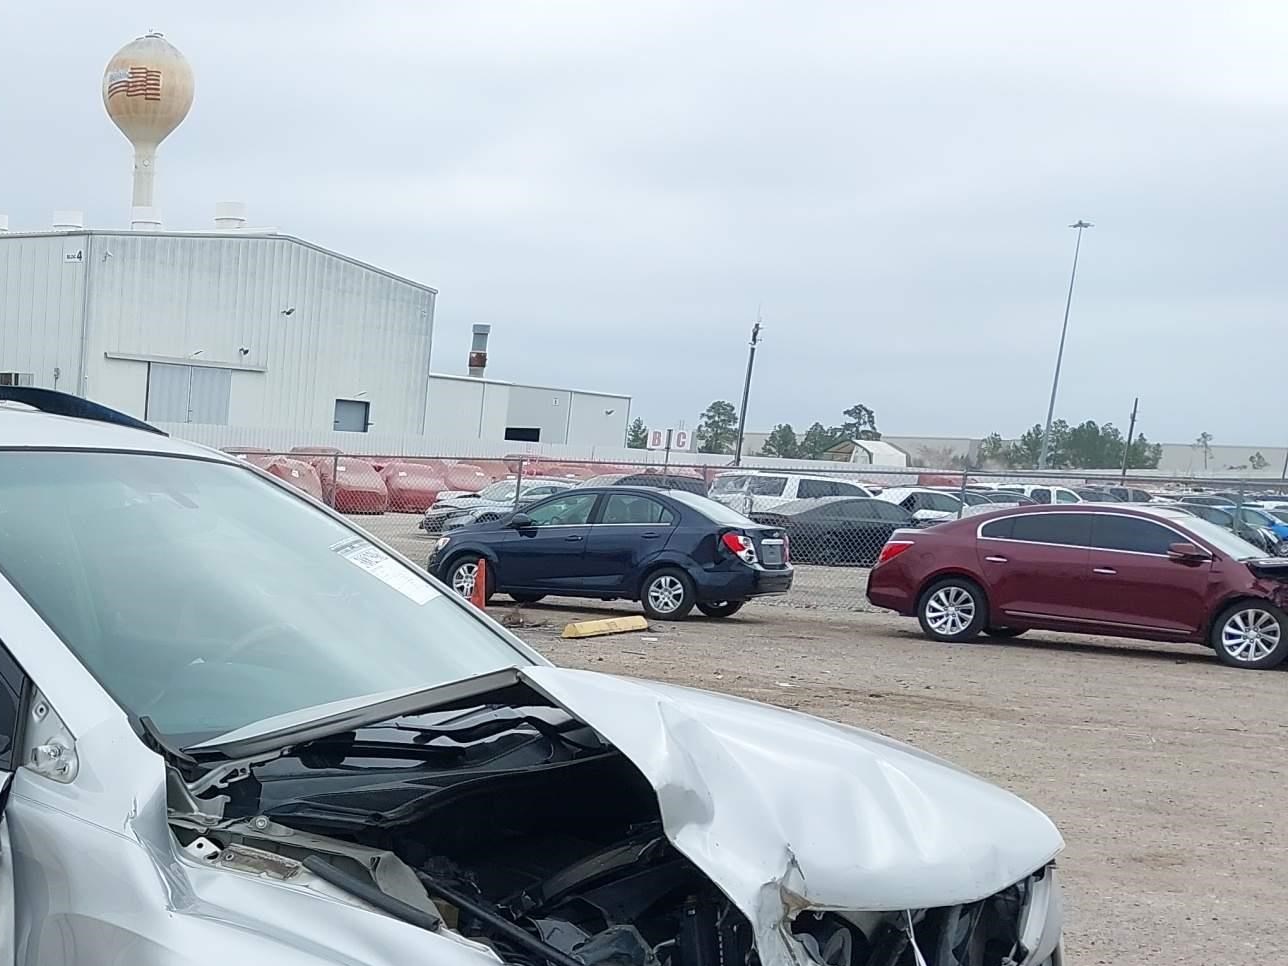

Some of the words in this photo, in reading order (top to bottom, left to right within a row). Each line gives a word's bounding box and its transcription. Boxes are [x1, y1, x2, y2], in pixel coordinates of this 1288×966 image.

[76, 250, 83, 261] 4
[652, 431, 662, 446] B
[676, 431, 687, 448] C
